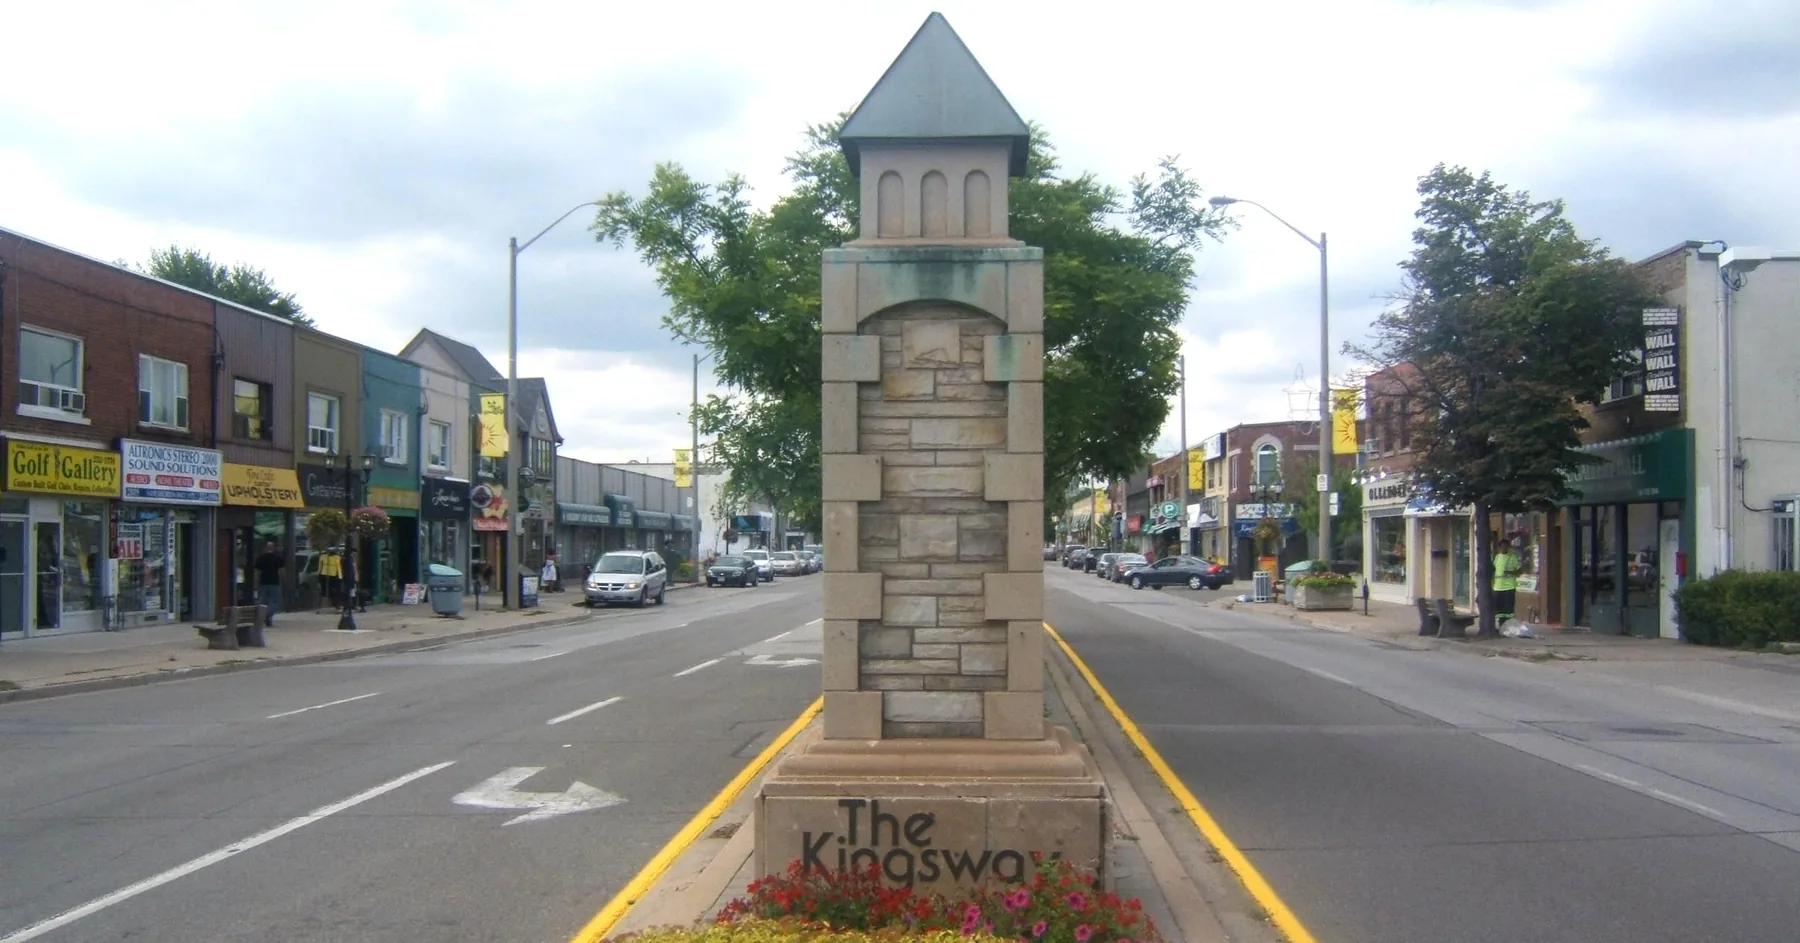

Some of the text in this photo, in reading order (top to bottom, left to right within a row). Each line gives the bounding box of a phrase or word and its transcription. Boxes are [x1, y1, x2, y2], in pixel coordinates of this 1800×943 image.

[1645, 333, 1675, 350] WALL
[1646, 355, 1676, 371] WALL
[1646, 375, 1676, 392] WALL
[128, 445, 171, 461] ALTRONICS
[173, 450, 199, 464] STEREO
[13, 450, 116, 485] Golf Gallery
[128, 459, 165, 472] SOUND
[167, 463, 218, 476] SOLUTIONS
[227, 485, 298, 500] UPHOLSTERY
[838, 799, 936, 847] The
